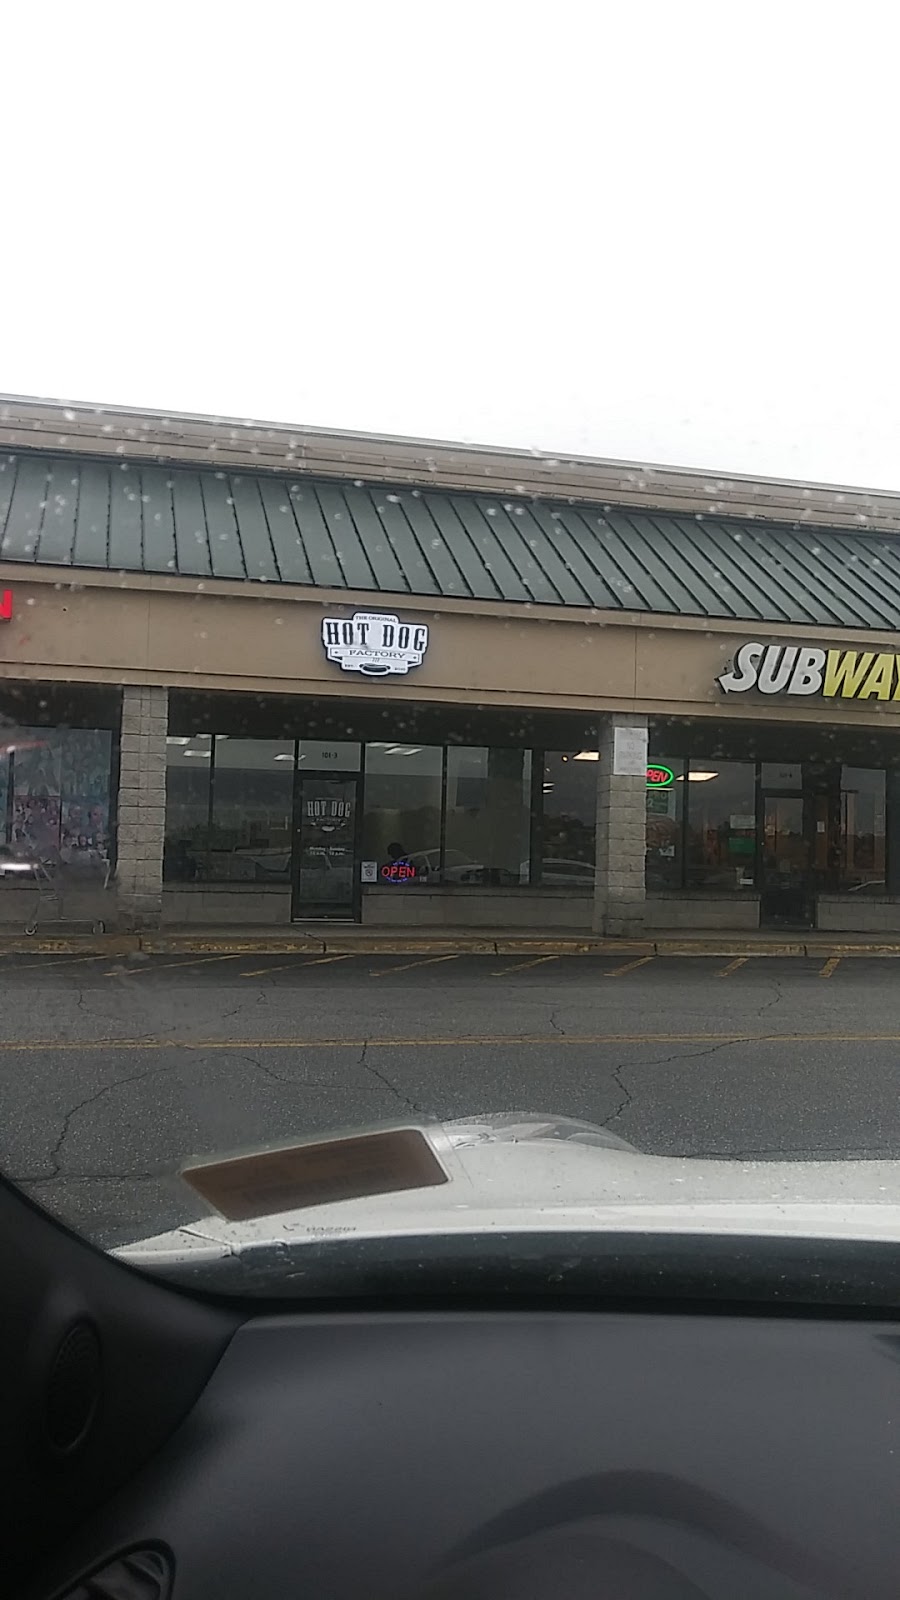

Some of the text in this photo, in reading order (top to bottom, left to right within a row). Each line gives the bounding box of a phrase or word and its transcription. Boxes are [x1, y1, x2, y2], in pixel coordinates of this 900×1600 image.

[325, 622, 426, 651] HOT DOG
[349, 649, 406, 659] FACTORY
[718, 642, 900, 701] SUBWA
[645, 769, 669, 782] PEN
[307, 801, 351, 818] HOT DOG
[381, 866, 416, 877] OPEN
